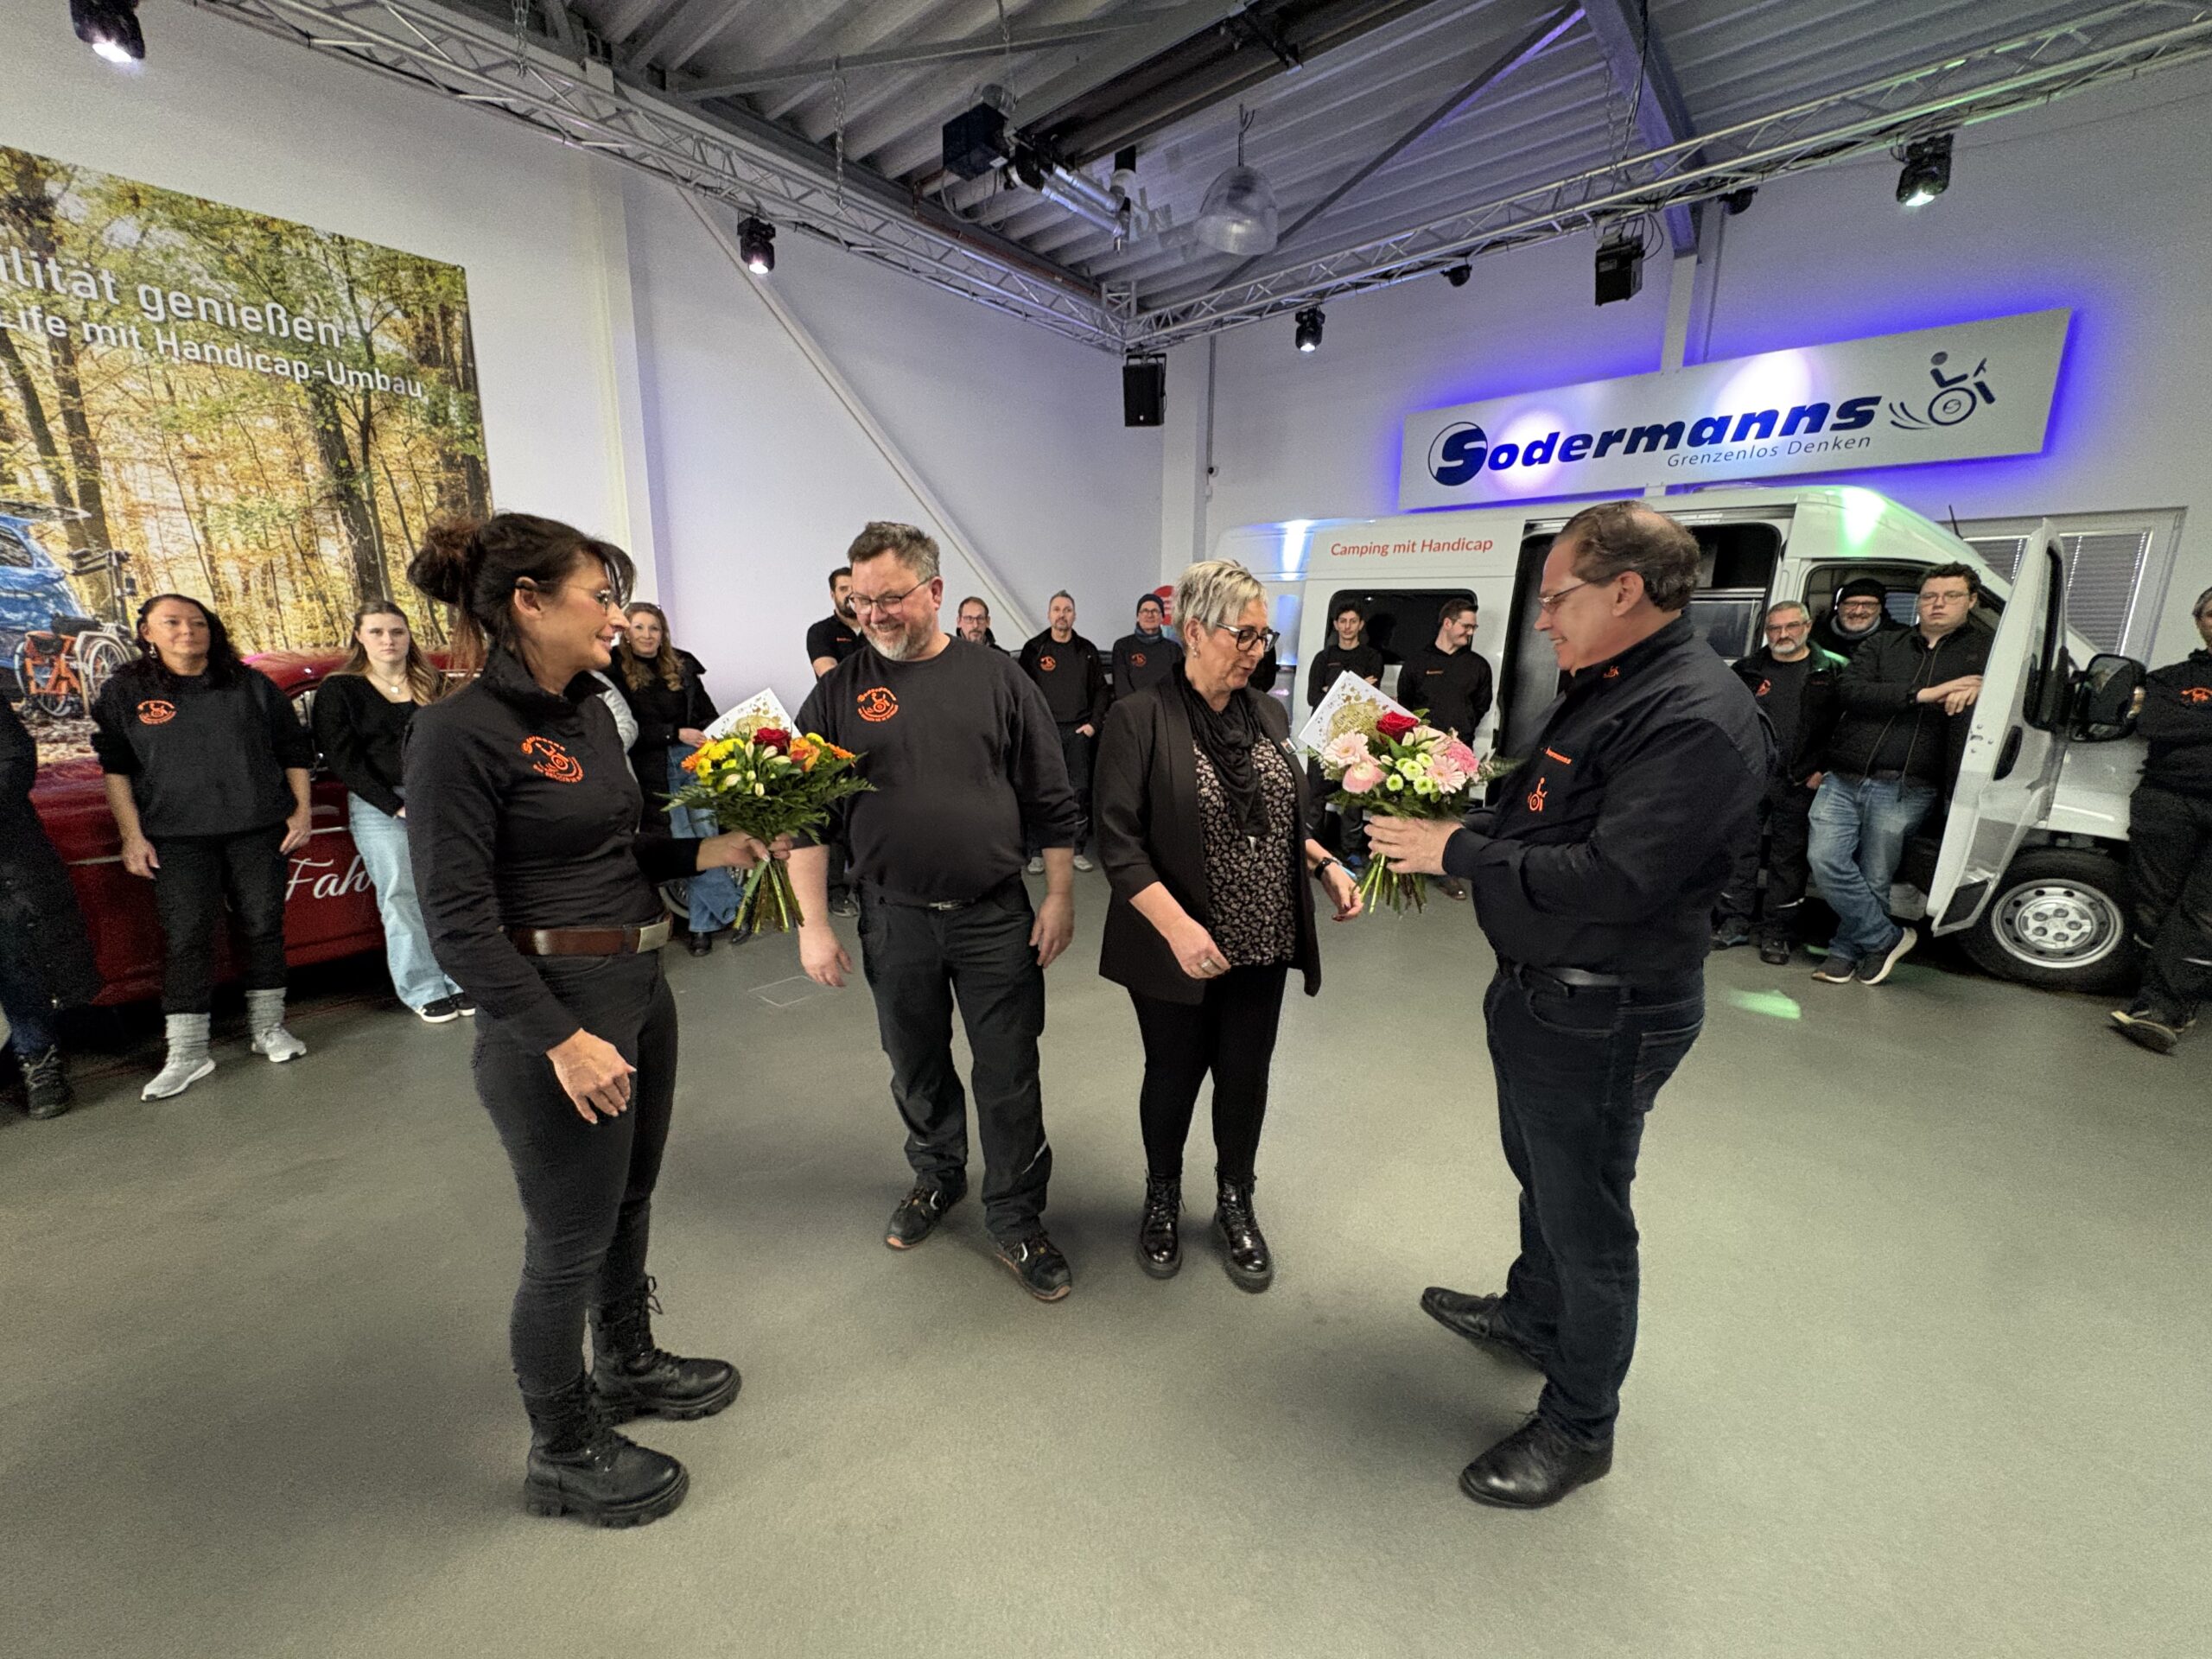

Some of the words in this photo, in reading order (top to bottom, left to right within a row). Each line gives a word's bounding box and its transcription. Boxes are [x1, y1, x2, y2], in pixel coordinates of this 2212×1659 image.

[137, 283, 340, 347] genießen
[82, 320, 144, 351] mit
[1428, 395, 1883, 486] Sodermanns
[1668, 444, 1779, 467] Grenzenlos
[1787, 435, 1871, 455] Denken
[1331, 541, 1390, 557] Camping
[1393, 539, 1417, 554] mit
[1421, 537, 1494, 554] Handicap
